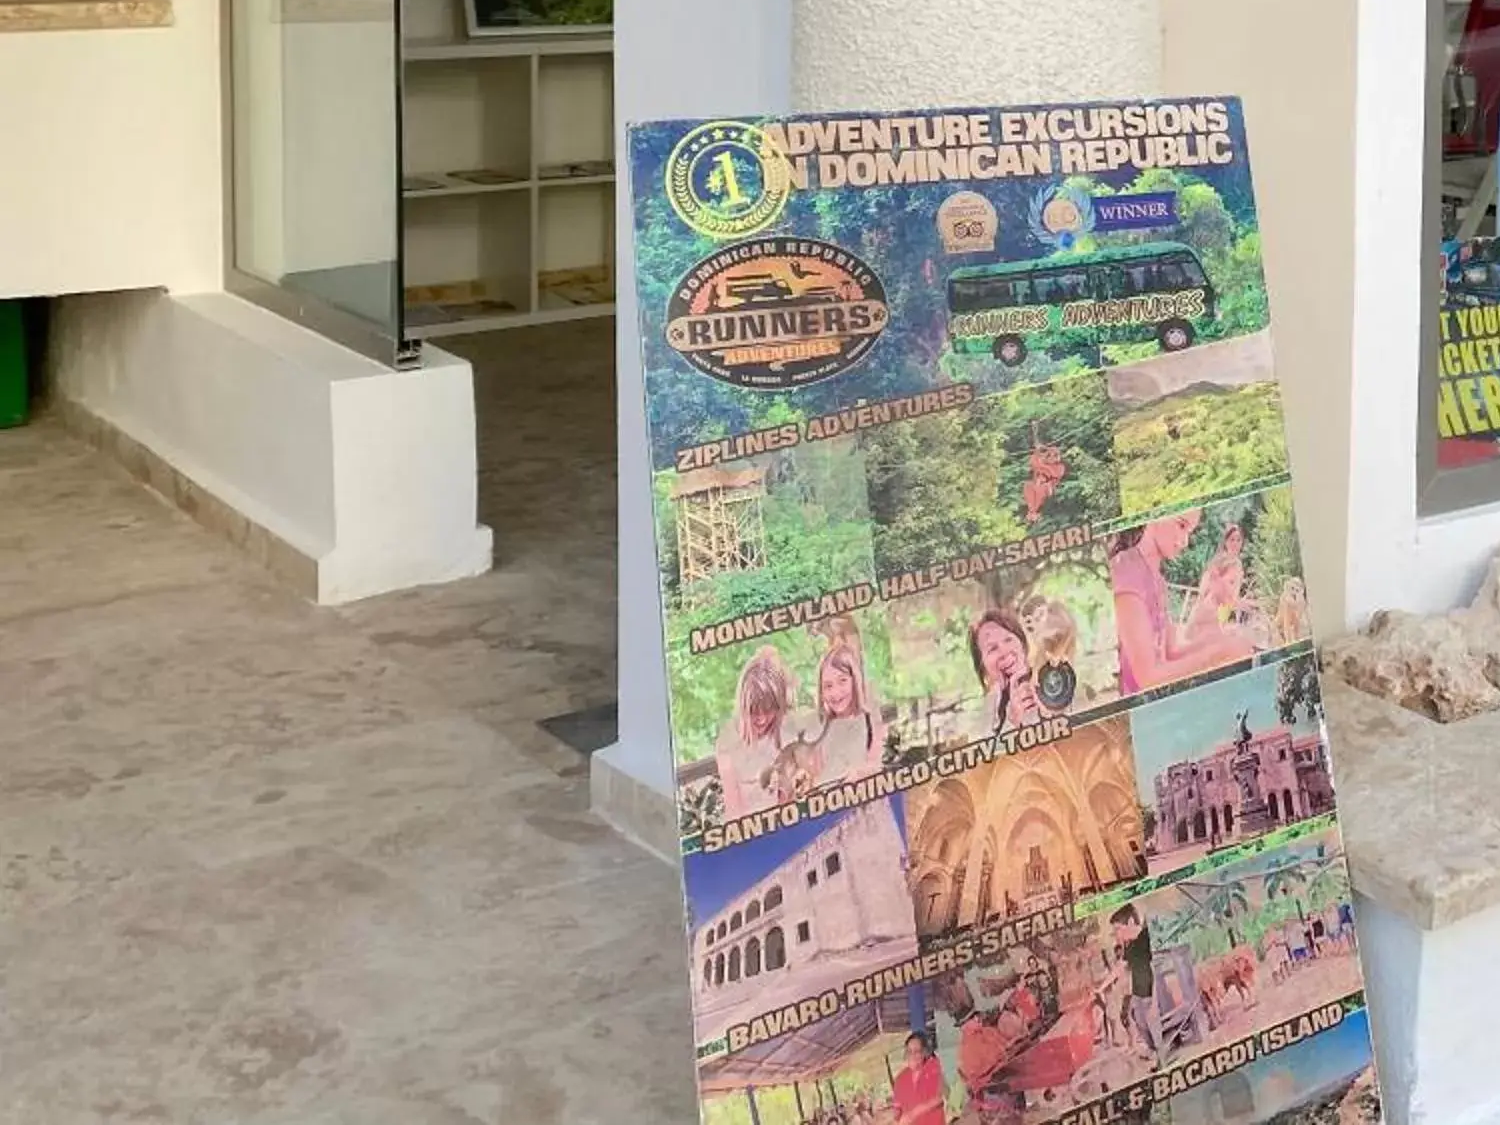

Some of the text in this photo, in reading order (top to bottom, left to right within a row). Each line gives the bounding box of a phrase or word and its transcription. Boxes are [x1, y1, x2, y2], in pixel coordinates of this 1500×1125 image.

[762, 102, 1229, 155] ADVENTURE EXCURSIONS
[819, 142, 1053, 188] DOMINICAN
[1060, 133, 1233, 174] REPUBLIC
[1100, 201, 1169, 221] WINNER
[678, 241, 873, 300] DOMINICAN REPUBLIC
[686, 305, 873, 346] RUNNERS
[1063, 289, 1205, 327] ADVENTURES
[724, 339, 842, 366] ADVENTURES
[677, 385, 974, 472] ZIPLINES ADVENTURES
[691, 524, 1092, 652] MONKEYLAND HALF DAY SAFARI
[704, 718, 1072, 853] SANTO DOMINGO CITY TOUR
[728, 906, 1074, 1051] BAVARO RUNNERS SAFARI
[1153, 1043, 1256, 1101] BACARDI
[1261, 1005, 1343, 1055] ISLAND
